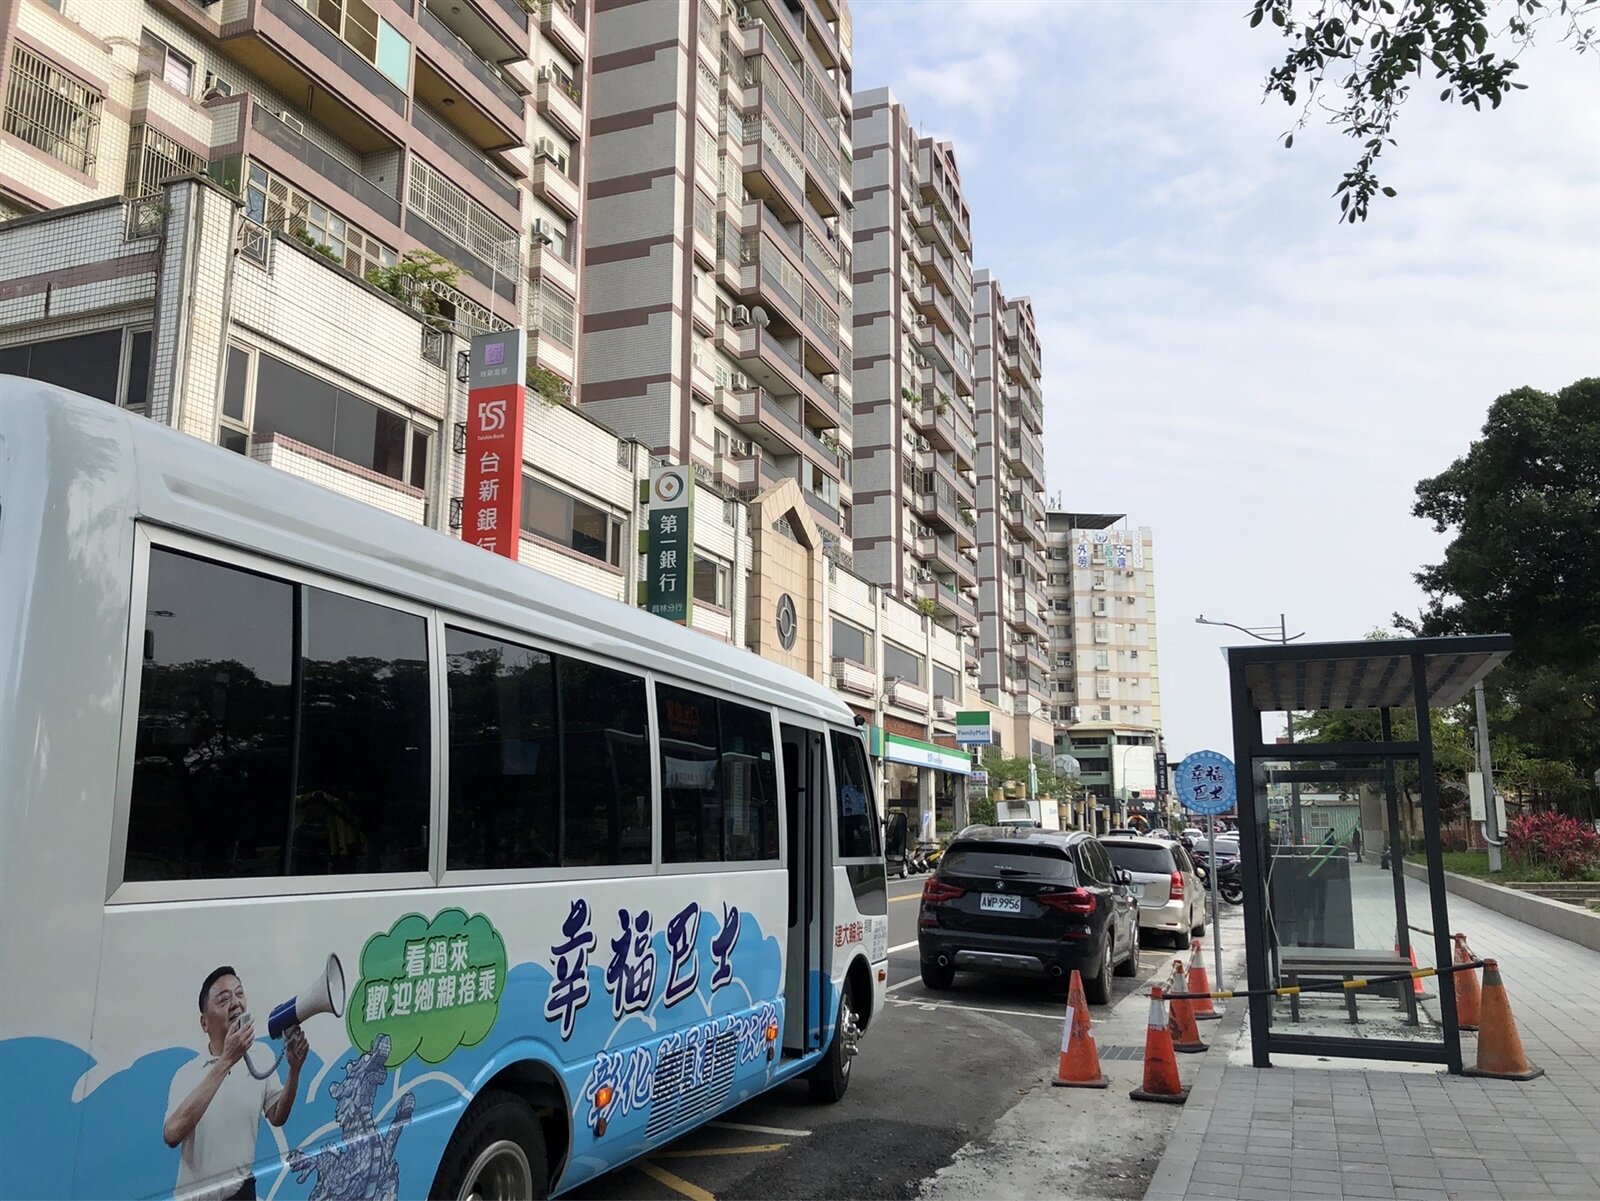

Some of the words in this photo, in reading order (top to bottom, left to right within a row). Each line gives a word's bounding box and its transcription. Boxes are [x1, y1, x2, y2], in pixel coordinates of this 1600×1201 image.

[476, 451, 500, 552] 台新銀行
[659, 514, 677, 592] 第一銀行
[651, 603, 683, 613] 員林分行
[957, 729, 989, 738] FamilyMart
[1191, 764, 1224, 783] 幸福
[1192, 784, 1223, 801] 巴士
[981, 896, 1020, 910] AWP-9956
[405, 939, 469, 978] 看過來
[546, 897, 741, 1036] 幸福巴士
[366, 968, 496, 1022] 歡迎鄉親搭乘
